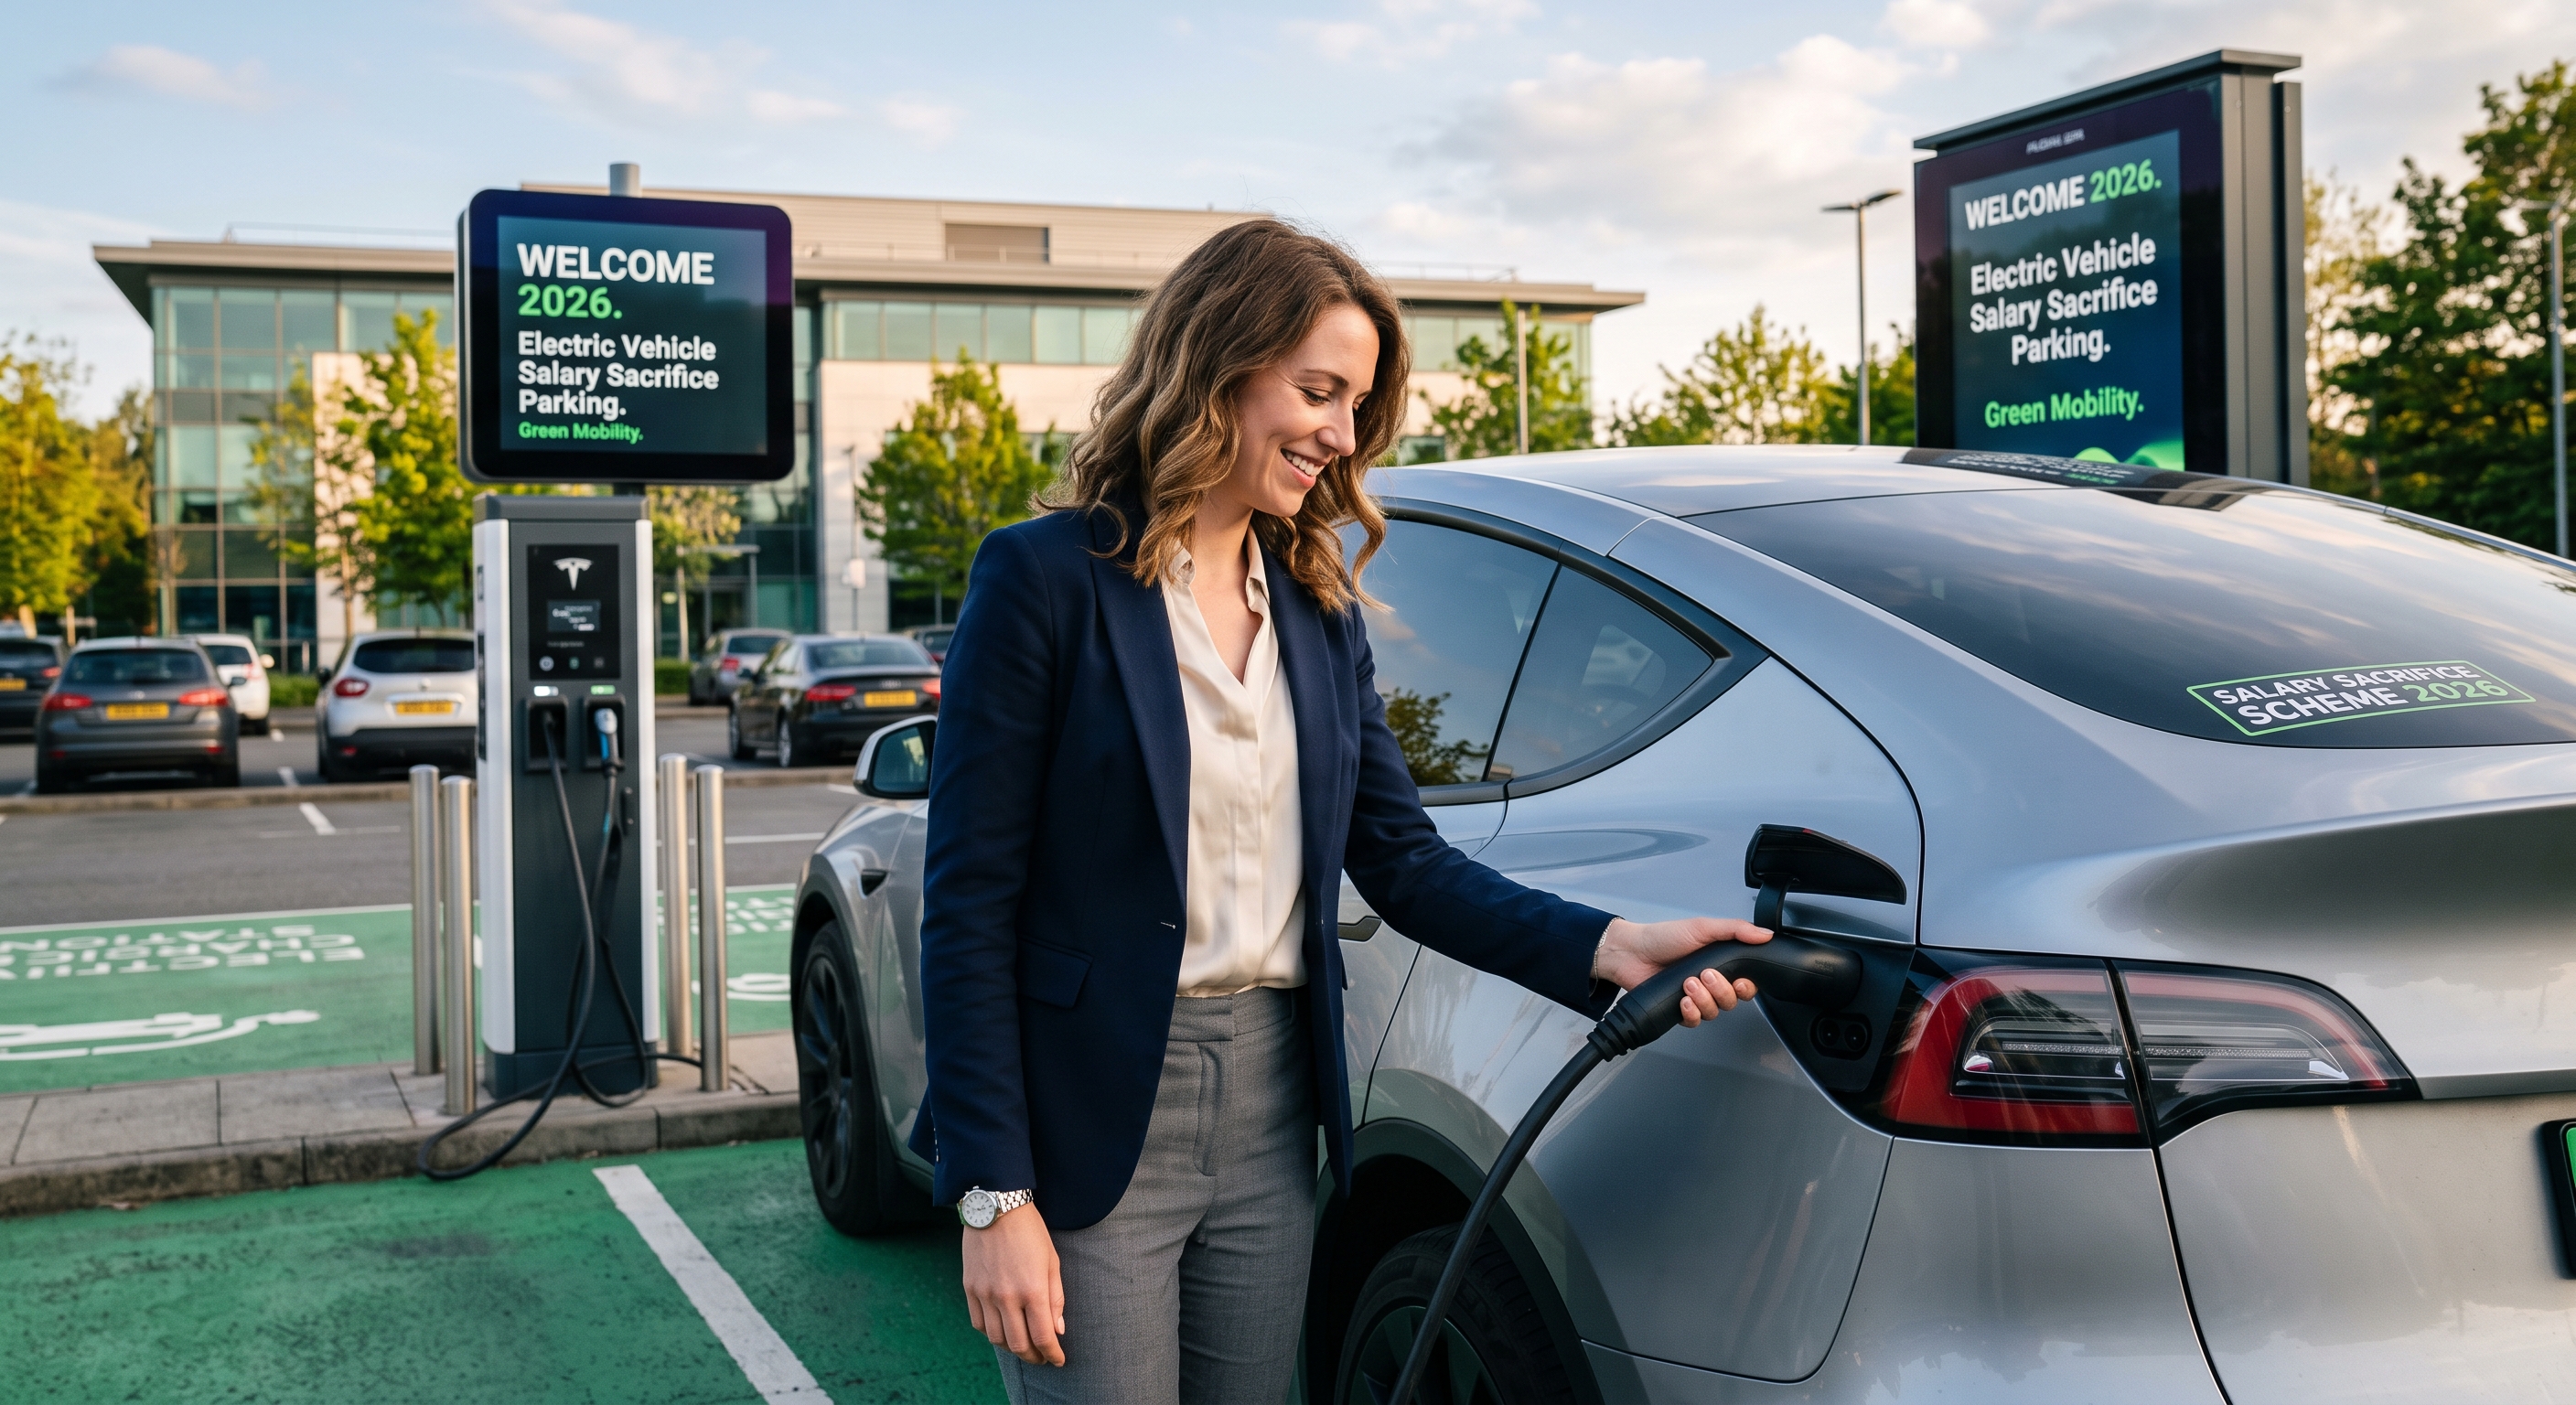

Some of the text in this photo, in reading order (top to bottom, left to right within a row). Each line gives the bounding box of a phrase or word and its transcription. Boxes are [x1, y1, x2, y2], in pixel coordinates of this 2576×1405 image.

[1965, 158, 2163, 231] WELCOME 2026.
[517, 243, 715, 285] WELCOME
[1970, 231, 2156, 296] Electric Vehicle
[518, 284, 623, 319] 2026.
[1970, 276, 2158, 333] Salary Sacrifice
[518, 330, 717, 361] Electric Vehicle
[2011, 328, 2111, 366] Parking.
[518, 359, 720, 392] Salary Sacrifice
[519, 389, 627, 422] Parking.
[1984, 386, 2144, 428] Green Mobility.
[518, 421, 644, 445] Green Mobility.
[2213, 665, 2483, 705] SALARY SACRIFICE
[2238, 680, 2509, 725] SCHEME 2026
